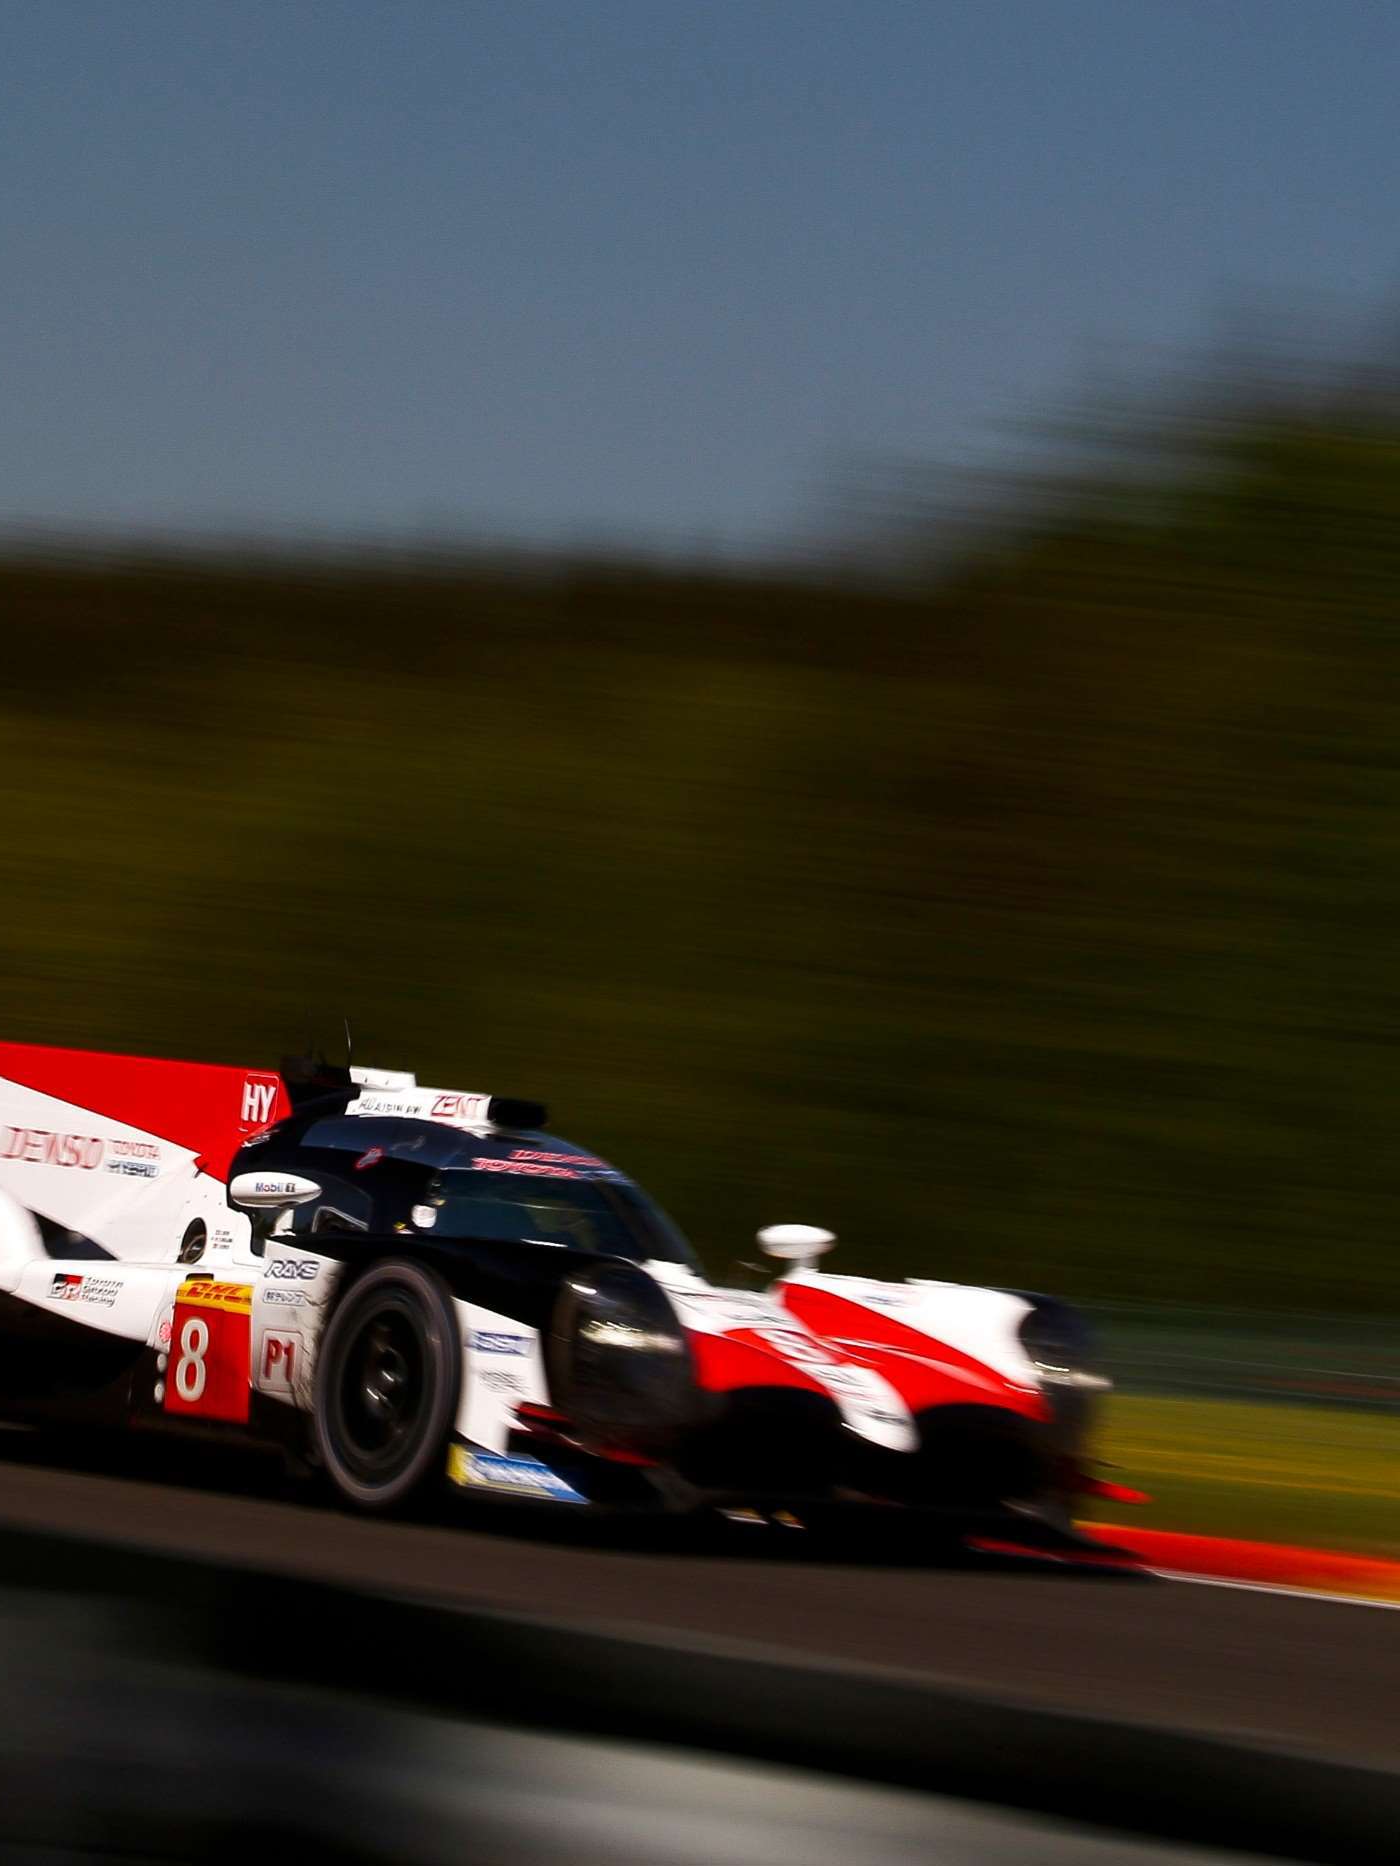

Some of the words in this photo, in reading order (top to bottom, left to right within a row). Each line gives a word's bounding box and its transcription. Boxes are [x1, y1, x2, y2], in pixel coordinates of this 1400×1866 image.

[240, 1081, 276, 1123] HY
[255, 1182, 284, 1193] Mobil
[264, 1260, 320, 1280] RAYS
[187, 1282, 244, 1301] DHL
[175, 1317, 209, 1403] 8
[264, 1338, 295, 1383] P1
